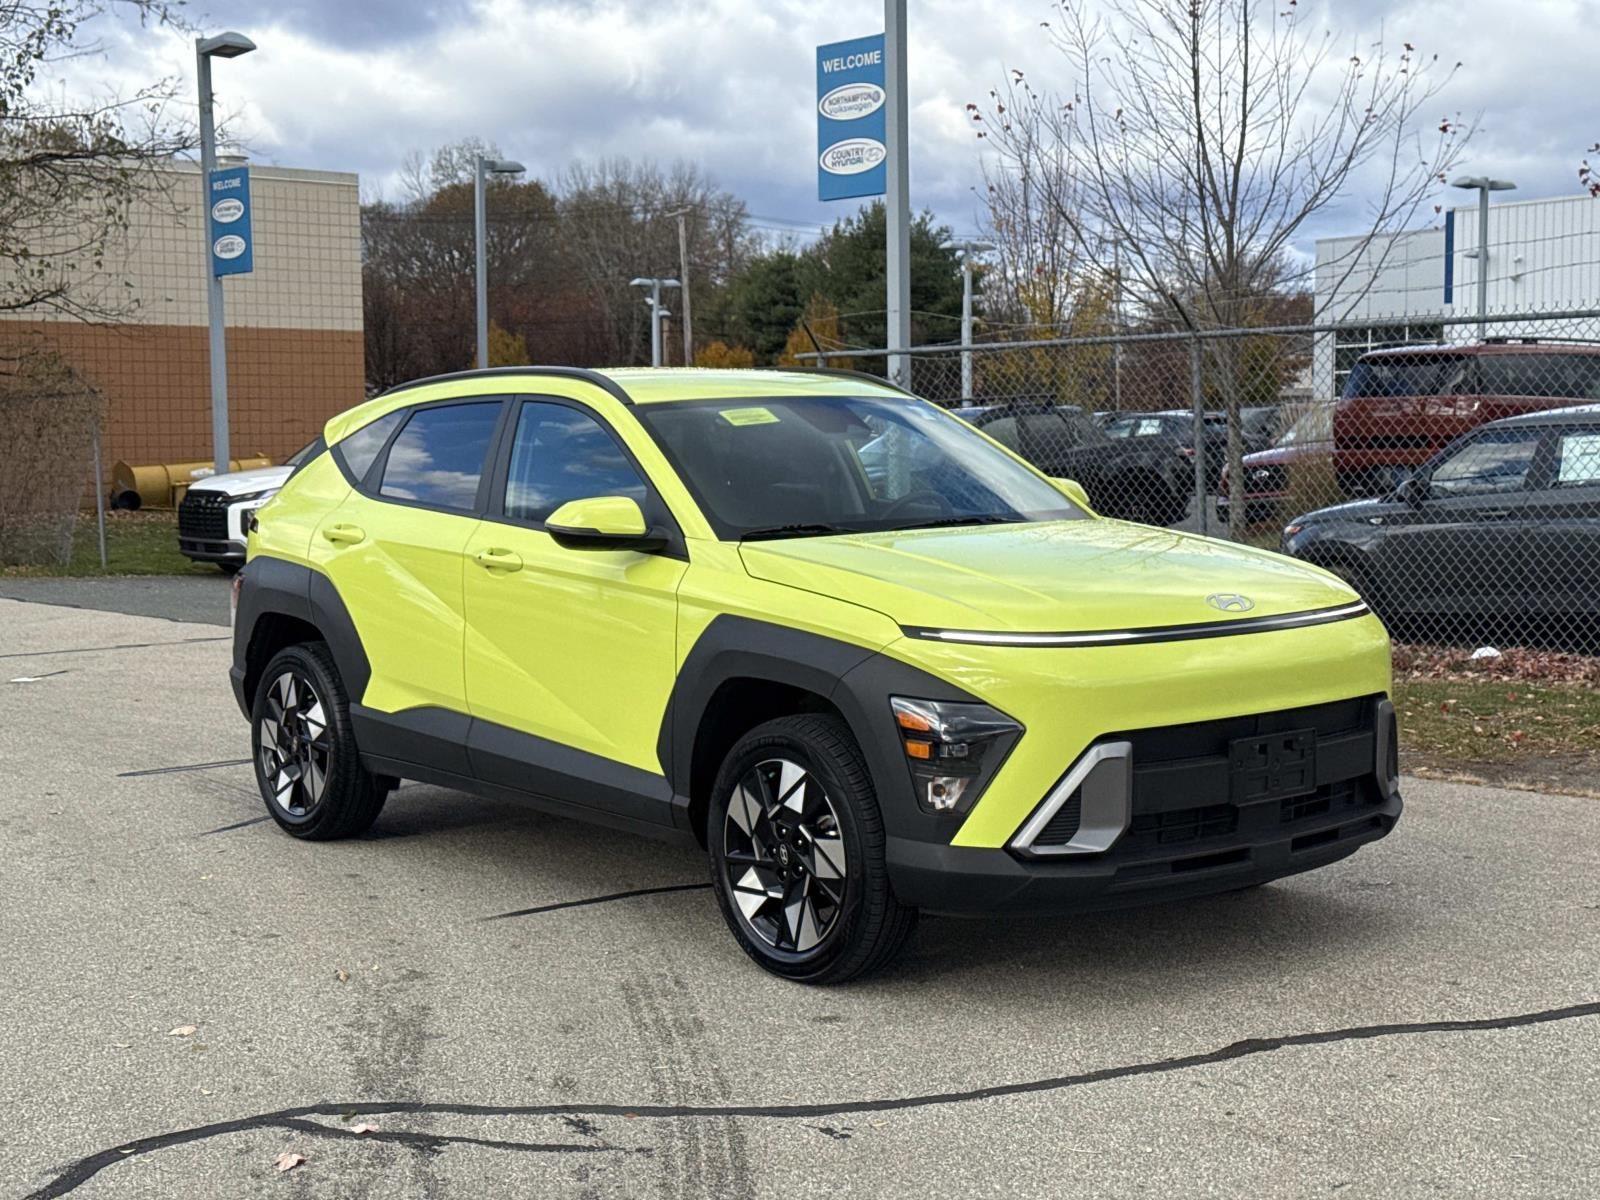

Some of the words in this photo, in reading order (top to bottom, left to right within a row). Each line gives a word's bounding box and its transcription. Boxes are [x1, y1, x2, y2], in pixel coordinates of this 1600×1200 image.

[823, 51, 881, 73] WELCOME
[831, 147, 865, 160] COUNTRY
[831, 157, 864, 168] HYUNDAI
